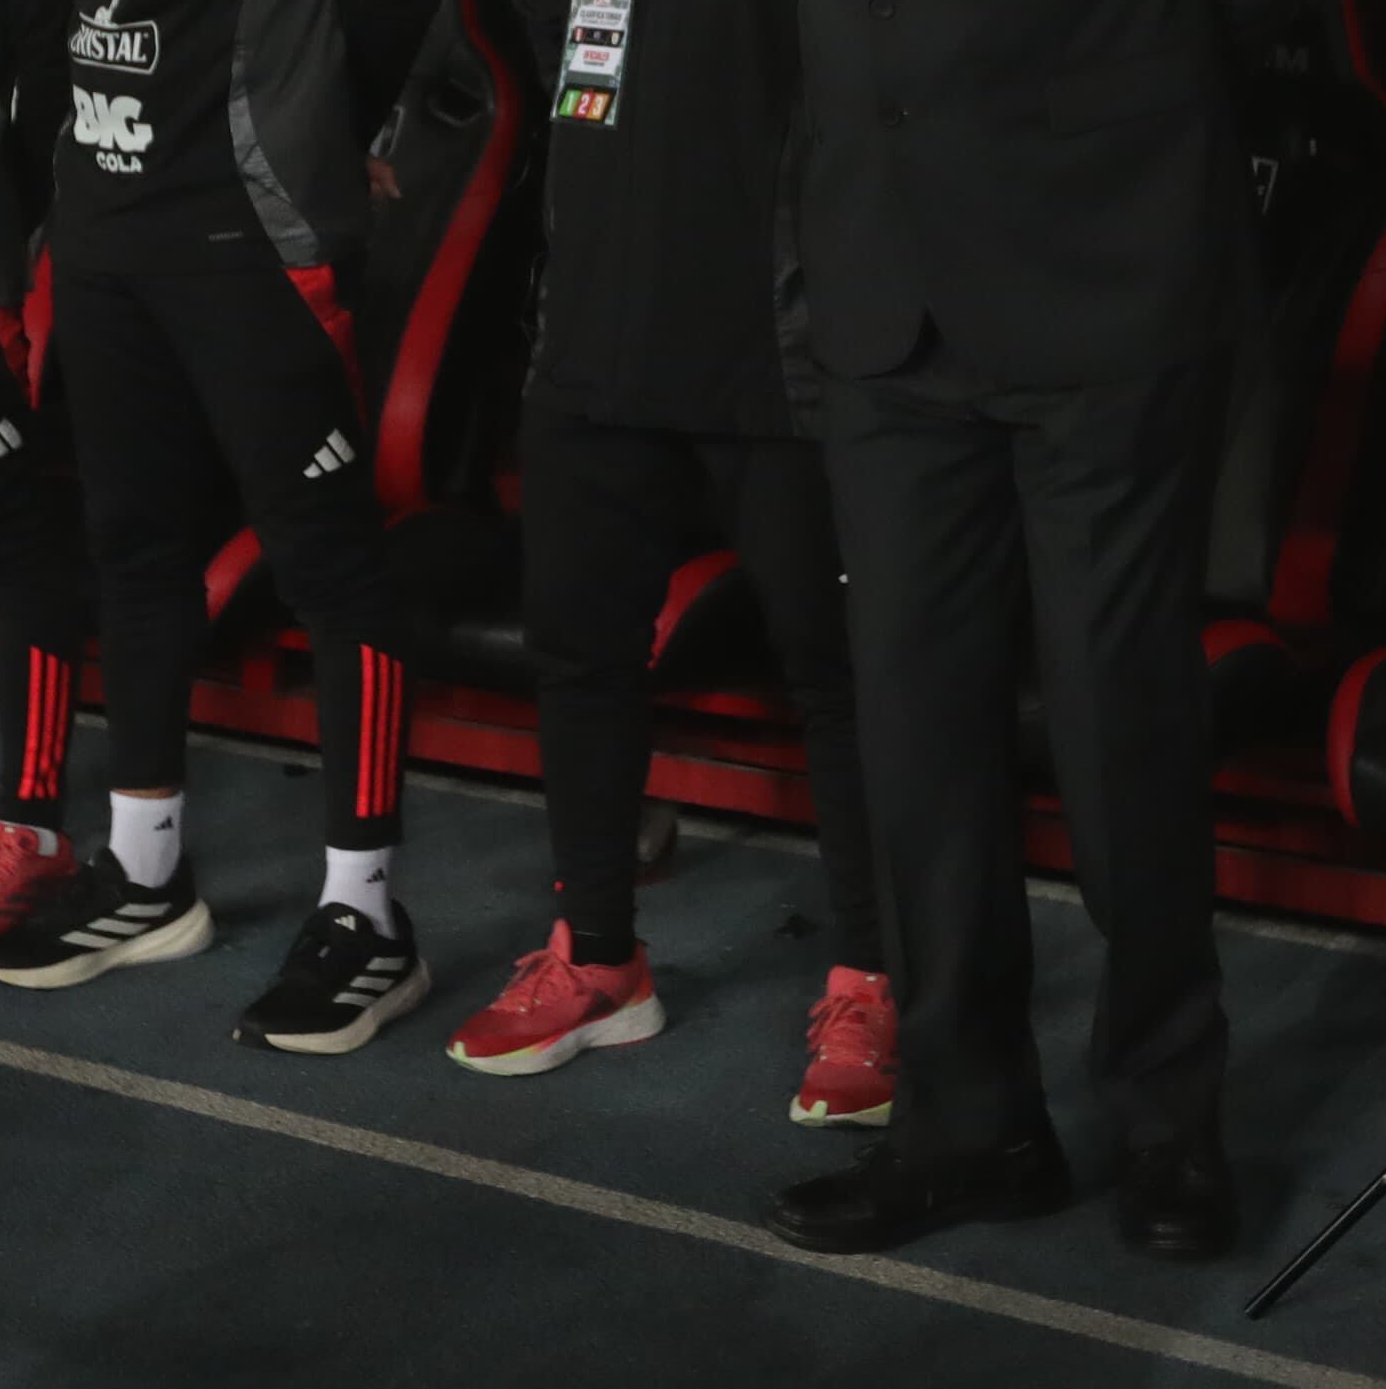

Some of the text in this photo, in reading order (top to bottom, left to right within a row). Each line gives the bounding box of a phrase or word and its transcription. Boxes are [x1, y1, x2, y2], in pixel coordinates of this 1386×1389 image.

[578, 92, 591, 115] 2
[73, 84, 153, 153] BIG
[96, 152, 144, 173] COLA
